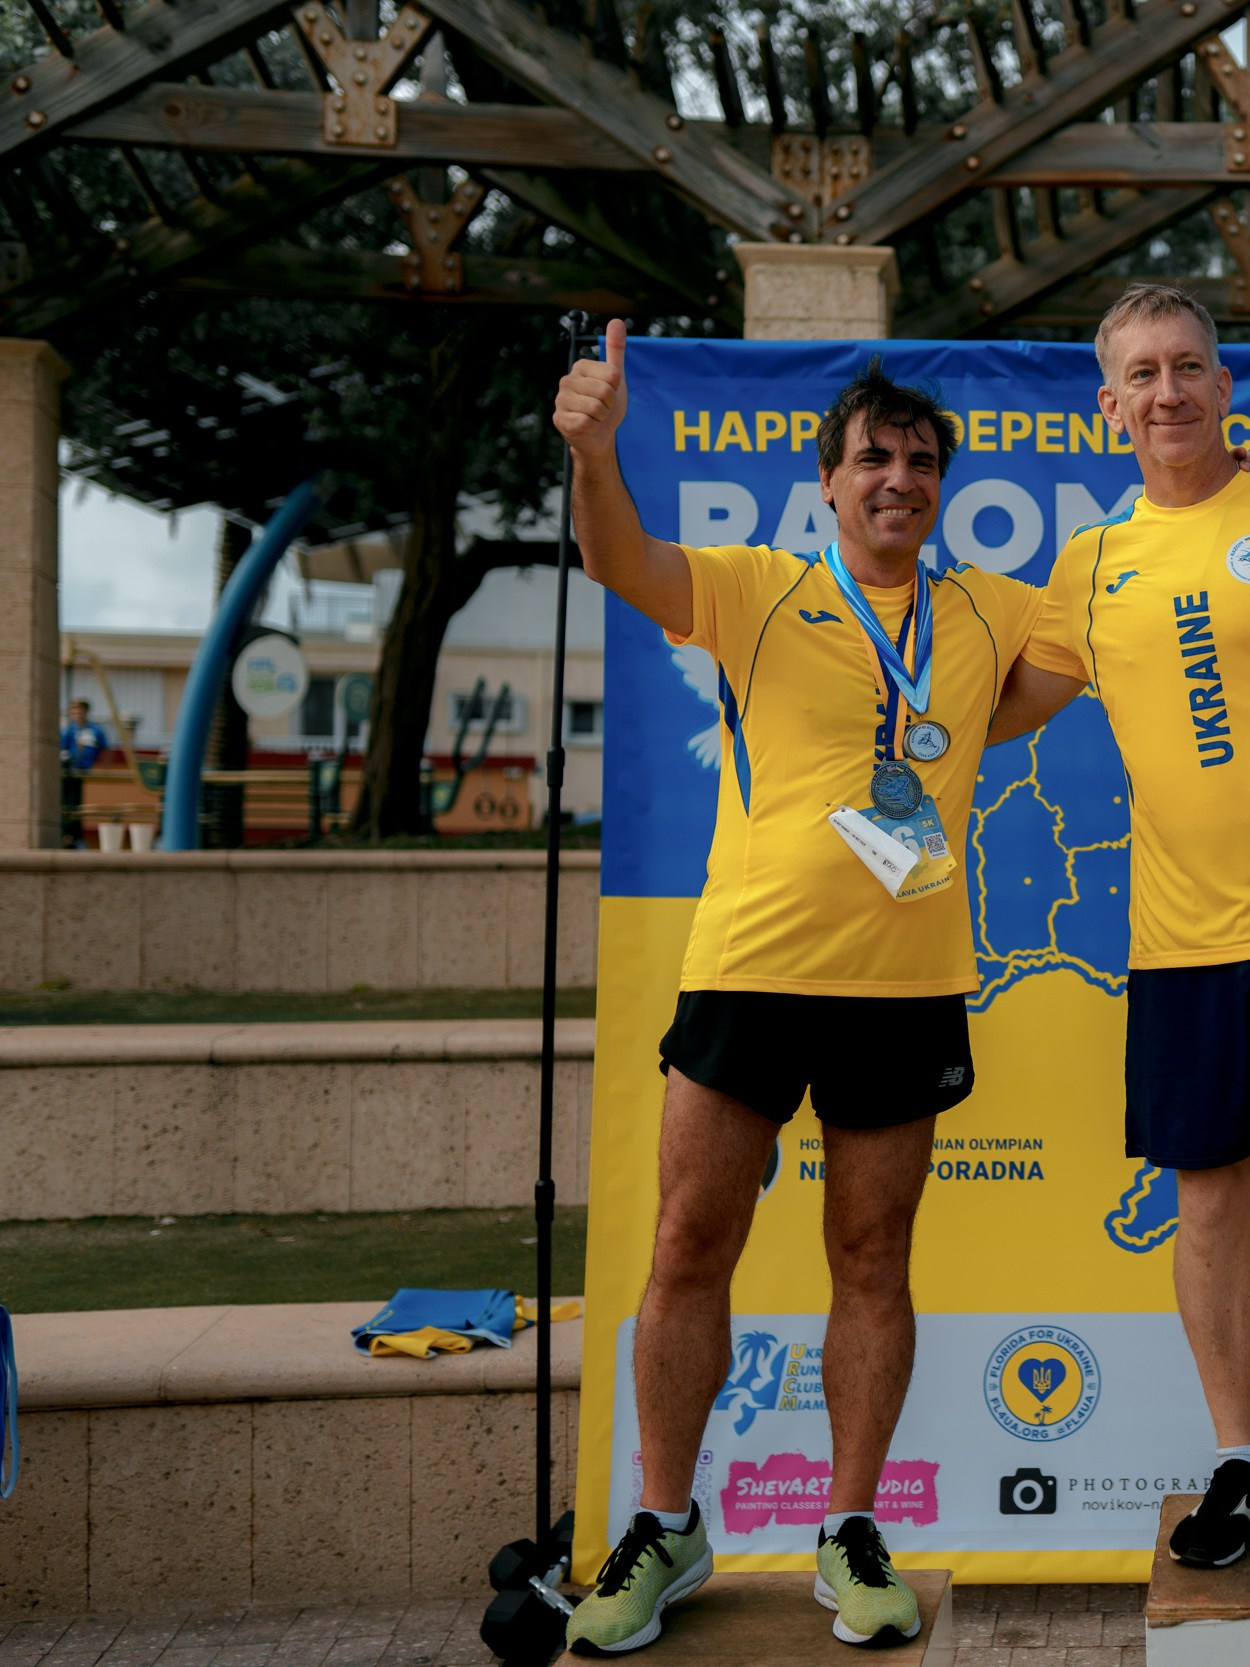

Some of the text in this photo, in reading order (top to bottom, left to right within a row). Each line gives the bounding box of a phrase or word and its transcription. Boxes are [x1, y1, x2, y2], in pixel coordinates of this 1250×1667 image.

[673, 410, 831, 452] HAPP
[679, 478, 1145, 574] RAOM
[1173, 590, 1234, 768] UKRAINE
[921, 819, 935, 828] 5K
[896, 888, 917, 898] LAVA
[969, 1138, 1043, 1150] OLYMPIAN
[990, 1329, 1094, 1378] FLORIDA FOR UKRAINE
[783, 1378, 823, 1394] CLUB
[778, 1396, 829, 1411] MIAM
[989, 1397, 1049, 1439] FL4UA.ORG
[1057, 1395, 1094, 1434] @FL4UA
[877, 1478, 925, 1495] UDIO
[1068, 1477, 1212, 1491] PHOTOGRAP
[735, 1502, 778, 1510] PAINTING
[779, 1502, 822, 1510] CLASSES
[891, 1500, 898, 1509] &
[900, 1500, 925, 1509] WINE
[1082, 1498, 1162, 1511] novikov-n
